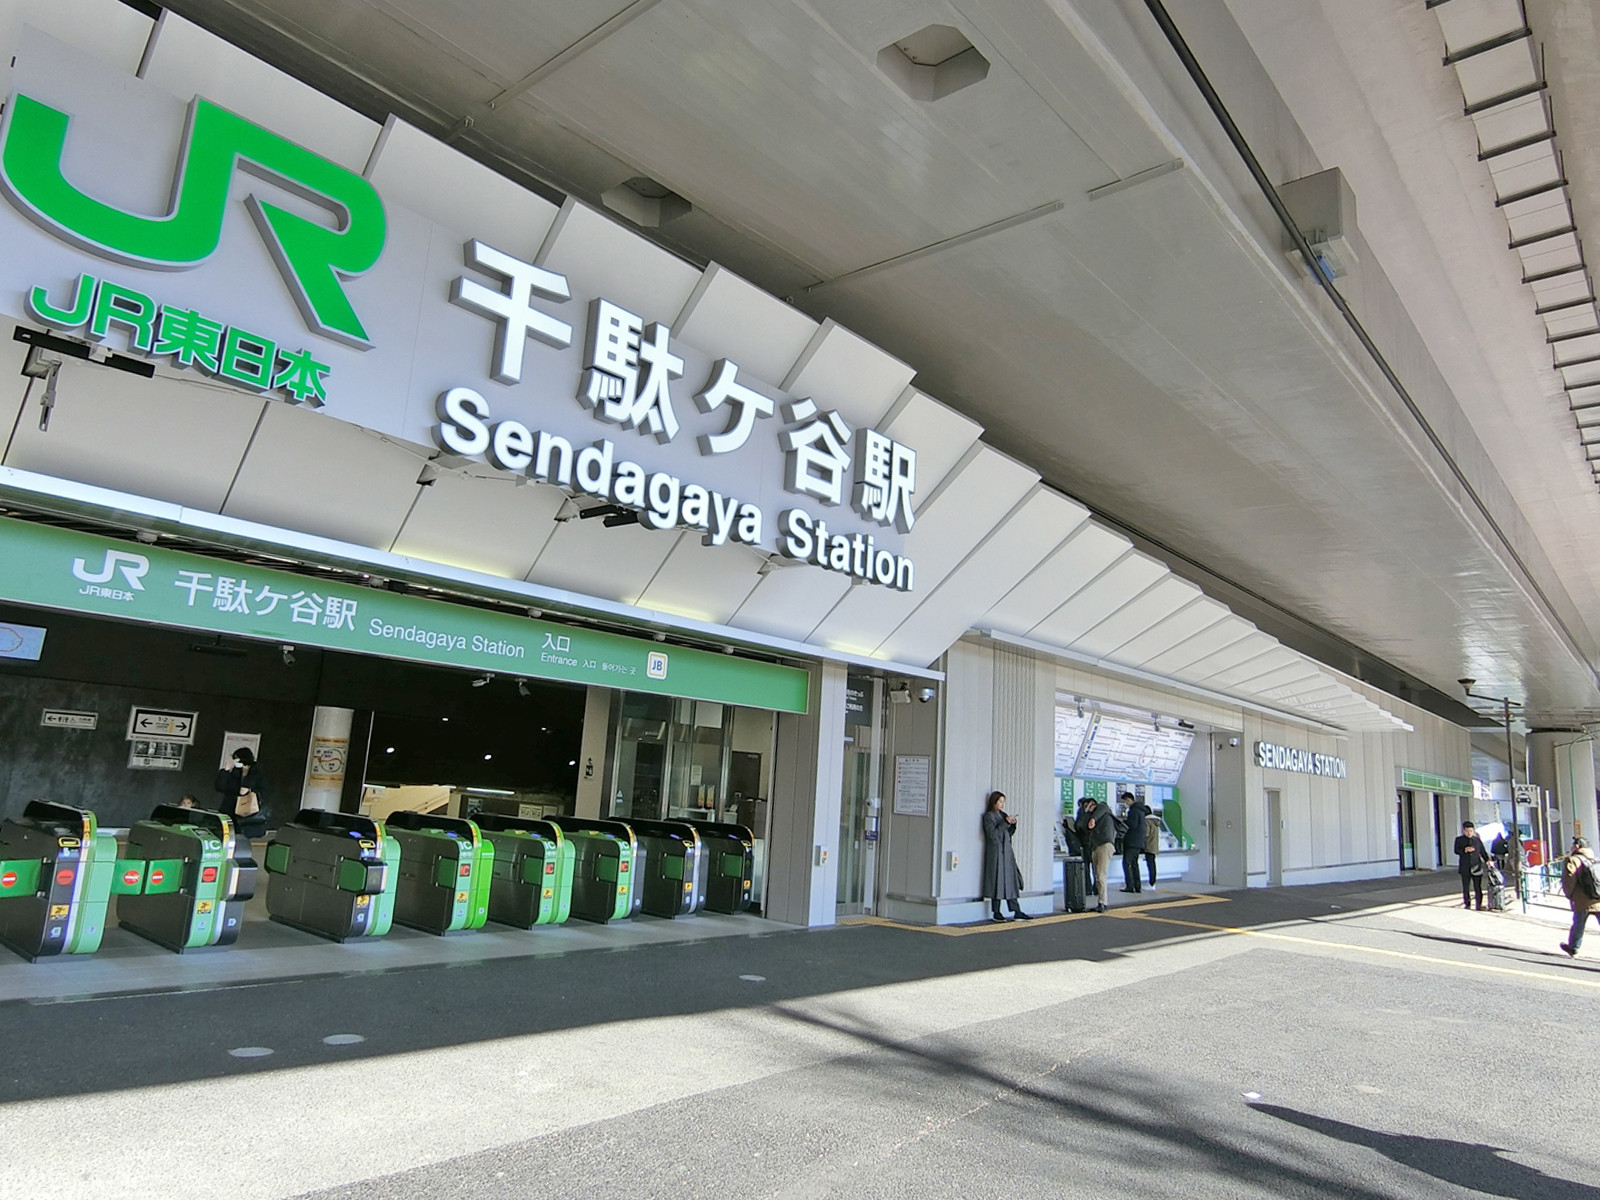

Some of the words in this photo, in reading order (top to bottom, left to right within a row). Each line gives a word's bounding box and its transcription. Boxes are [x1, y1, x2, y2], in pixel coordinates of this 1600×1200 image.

[0, 92, 388, 350] JR
[25, 272, 331, 407] JR東日本
[434, 387, 763, 546] Sendagaya
[779, 508, 915, 592] Station
[72, 549, 150, 591] JR
[78, 585, 135, 602] JR東日本
[369, 617, 467, 652] Sendagaya
[471, 635, 525, 659] Station
[540, 633, 571, 653] 入口
[540, 652, 578, 667] Entrance
[582, 660, 597, 670] 入口
[651, 659, 663, 671] JB
[1256, 741, 1314, 774] SENDAGAYA
[1314, 752, 1347, 779] STATION
[1516, 785, 1534, 793] AXI
[203, 839, 221, 851] IC
